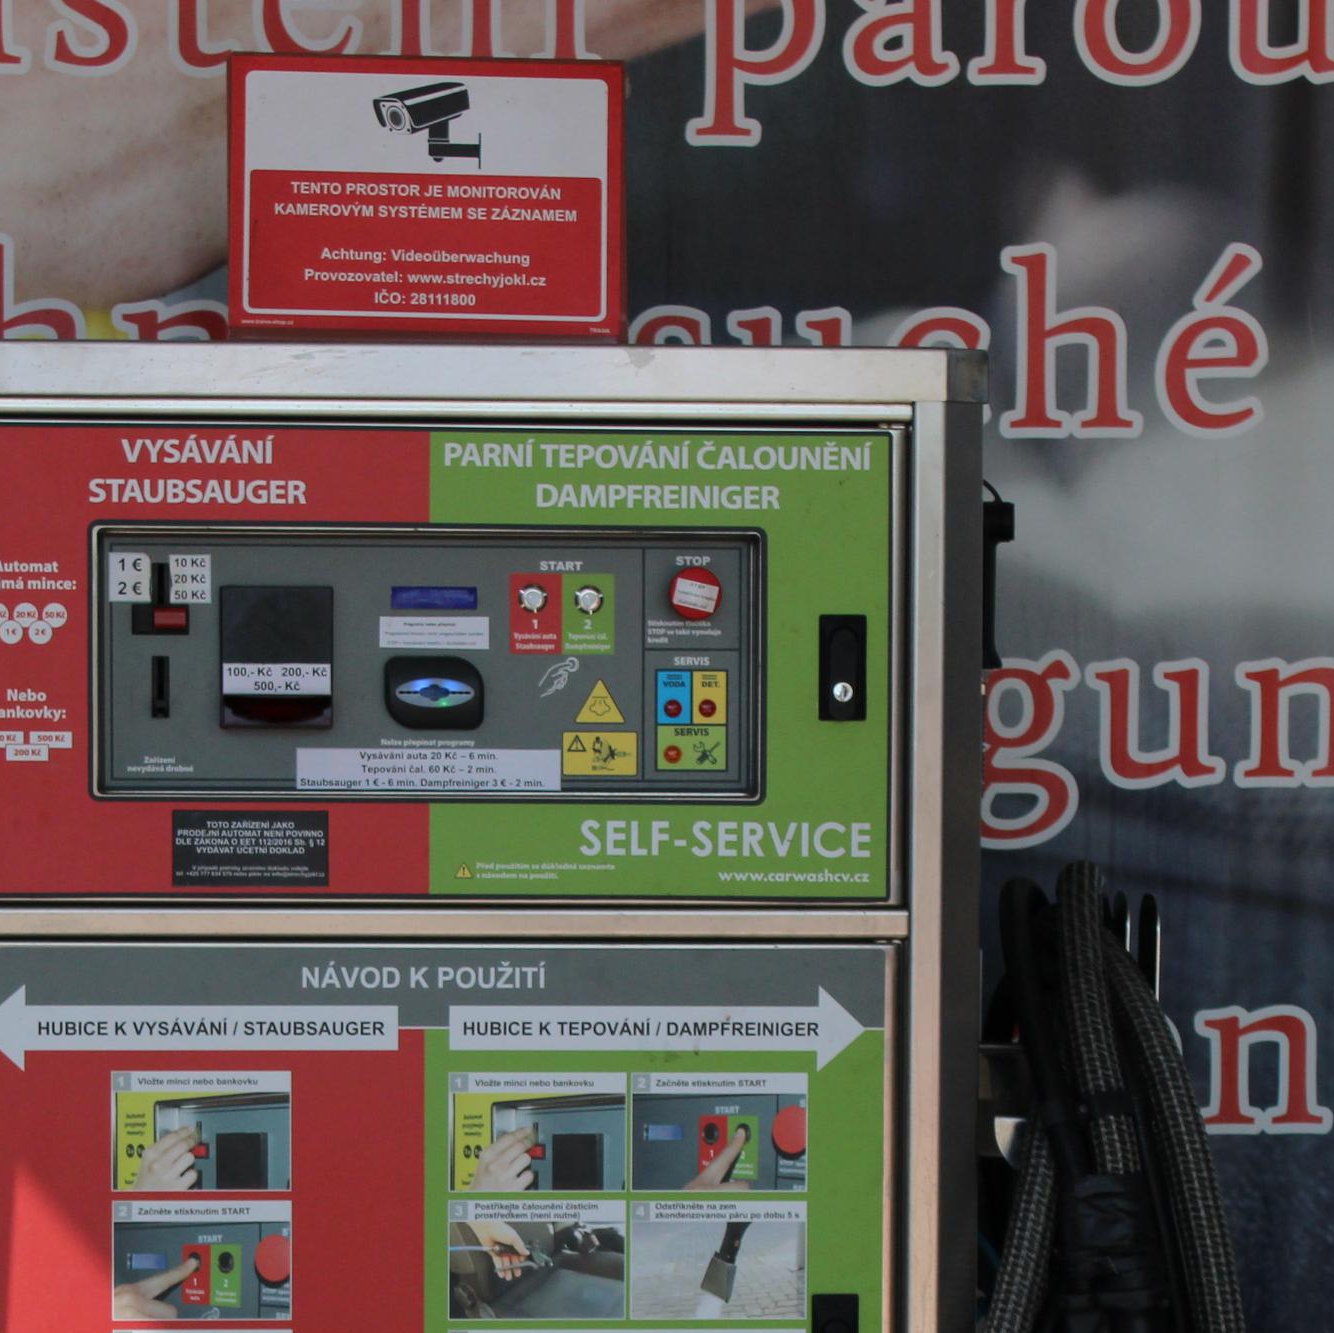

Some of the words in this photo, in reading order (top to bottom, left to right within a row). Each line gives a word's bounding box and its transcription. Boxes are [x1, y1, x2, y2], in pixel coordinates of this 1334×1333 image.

[290, 181, 341, 195] TENTO
[345, 182, 420, 196] PROSTOR
[423, 184, 443, 197] JE
[447, 183, 560, 200] MONITOROVÁN
[274, 200, 373, 217] KAMEROVÝM
[378, 202, 462, 219] SYSTÉMEM
[467, 206, 487, 220] SE
[490, 205, 577, 222] ZÁZNAMEM
[320, 247, 386, 264] Achtung:
[390, 248, 530, 267] Videoüberwachung
[304, 268, 402, 283] Provozovatel:
[407, 271, 546, 289] www.strechyjokl.cz
[374, 289, 405, 304] IČO:
[410, 292, 475, 306] 28111800
[121, 434, 274, 464] VYSÁVÁNÍ
[444, 437, 534, 467] PARNÍ
[539, 439, 690, 469] TEPOVÁNÍ
[696, 440, 871, 470] ČALOUNĚNÍ
[89, 478, 306, 504] STAUBSAUGER
[536, 483, 779, 509] DAMPFREINIGER
[118, 558, 126, 571] 1
[132, 558, 143, 571] €
[174, 558, 187, 568] 10
[191, 557, 206, 568] Kč
[540, 561, 583, 571] START
[675, 556, 711, 566] STOP
[27, 576, 76, 590] mince:
[174, 574, 188, 584] 20
[191, 572, 206, 584] Kč
[118, 582, 127, 595] 2
[132, 582, 143, 595] €
[174, 590, 188, 600] 50
[191, 589, 206, 600] Kč
[531, 619, 540, 630] 1
[583, 619, 593, 630] 2
[673, 656, 710, 666] SERVIS
[226, 666, 255, 679] 100,-
[256, 665, 273, 678] Kč
[280, 666, 310, 679] 200,-
[311, 666, 328, 678] Kč
[253, 680, 280, 694] 500,-
[282, 680, 300, 692] Kč
[6, 688, 46, 701] Nebo
[673, 728, 710, 736] SERVIS
[359, 751, 405, 763] Vysávání
[406, 752, 428, 761] auta
[431, 751, 443, 761] 20
[444, 750, 458, 761] Kč
[468, 751, 475, 761] 6
[476, 751, 499, 761] min.
[361, 765, 407, 777] Tepování
[428, 765, 441, 775] 60
[443, 764, 457, 775] Kč
[467, 765, 474, 775] 2
[475, 765, 497, 775] min.
[579, 819, 870, 858] SELF-SERVICE
[718, 868, 869, 882] www.carwashcv.cz
[302, 960, 400, 988] NÁVOD
[410, 966, 428, 988] K
[437, 961, 545, 988] POUŽITÍ
[38, 1021, 108, 1035] HUBICE
[114, 1021, 126, 1035] K
[132, 1017, 226, 1035] VYSÁVÁNÍ
[243, 1021, 384, 1035] STAUBSAUGER
[463, 1021, 532, 1035] HUBICE
[539, 1021, 551, 1035] K
[556, 1018, 650, 1036] TEPOVÁNÍ
[666, 1017, 818, 1036] DAMPFREINIGER
